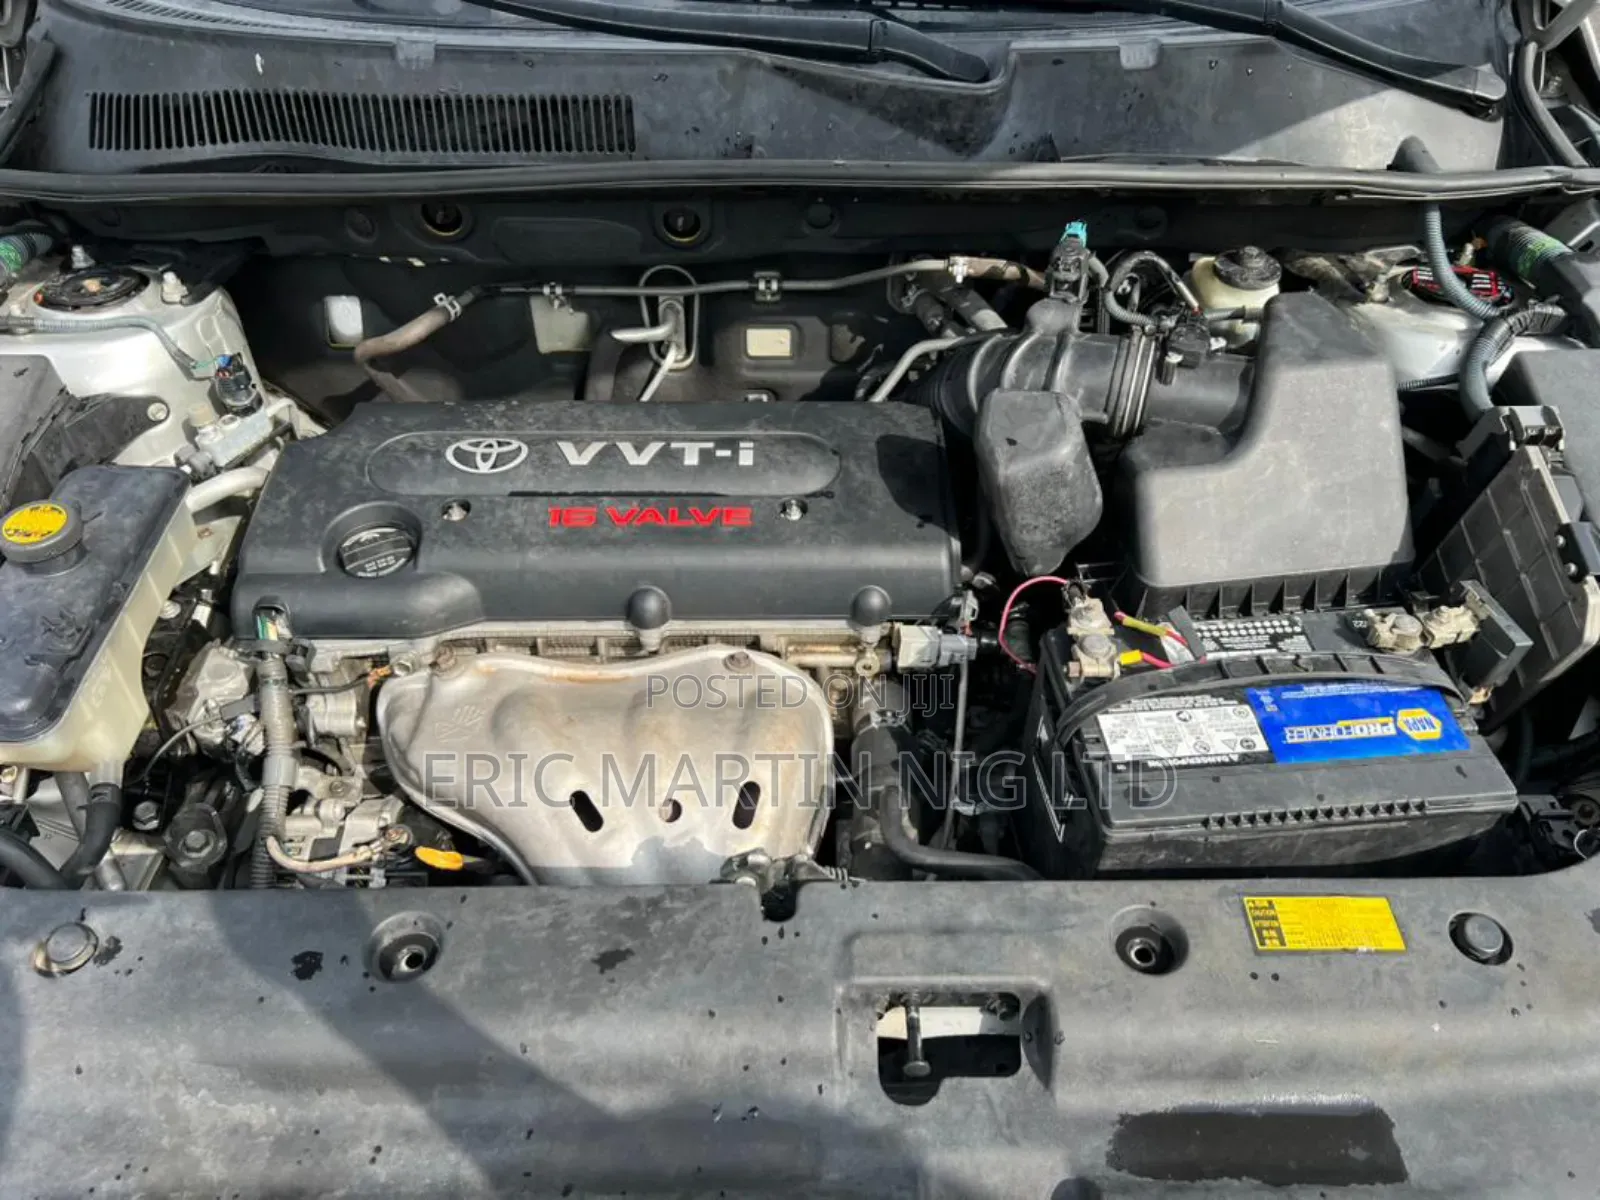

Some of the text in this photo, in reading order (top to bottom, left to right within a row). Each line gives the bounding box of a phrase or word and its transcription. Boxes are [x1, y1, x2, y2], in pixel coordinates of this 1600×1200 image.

[557, 441, 754, 466] VVT-i
[548, 506, 754, 528] 16 VALVE
[1285, 722, 1397, 744] PROFORMER
[1403, 716, 1436, 732] NAPA
